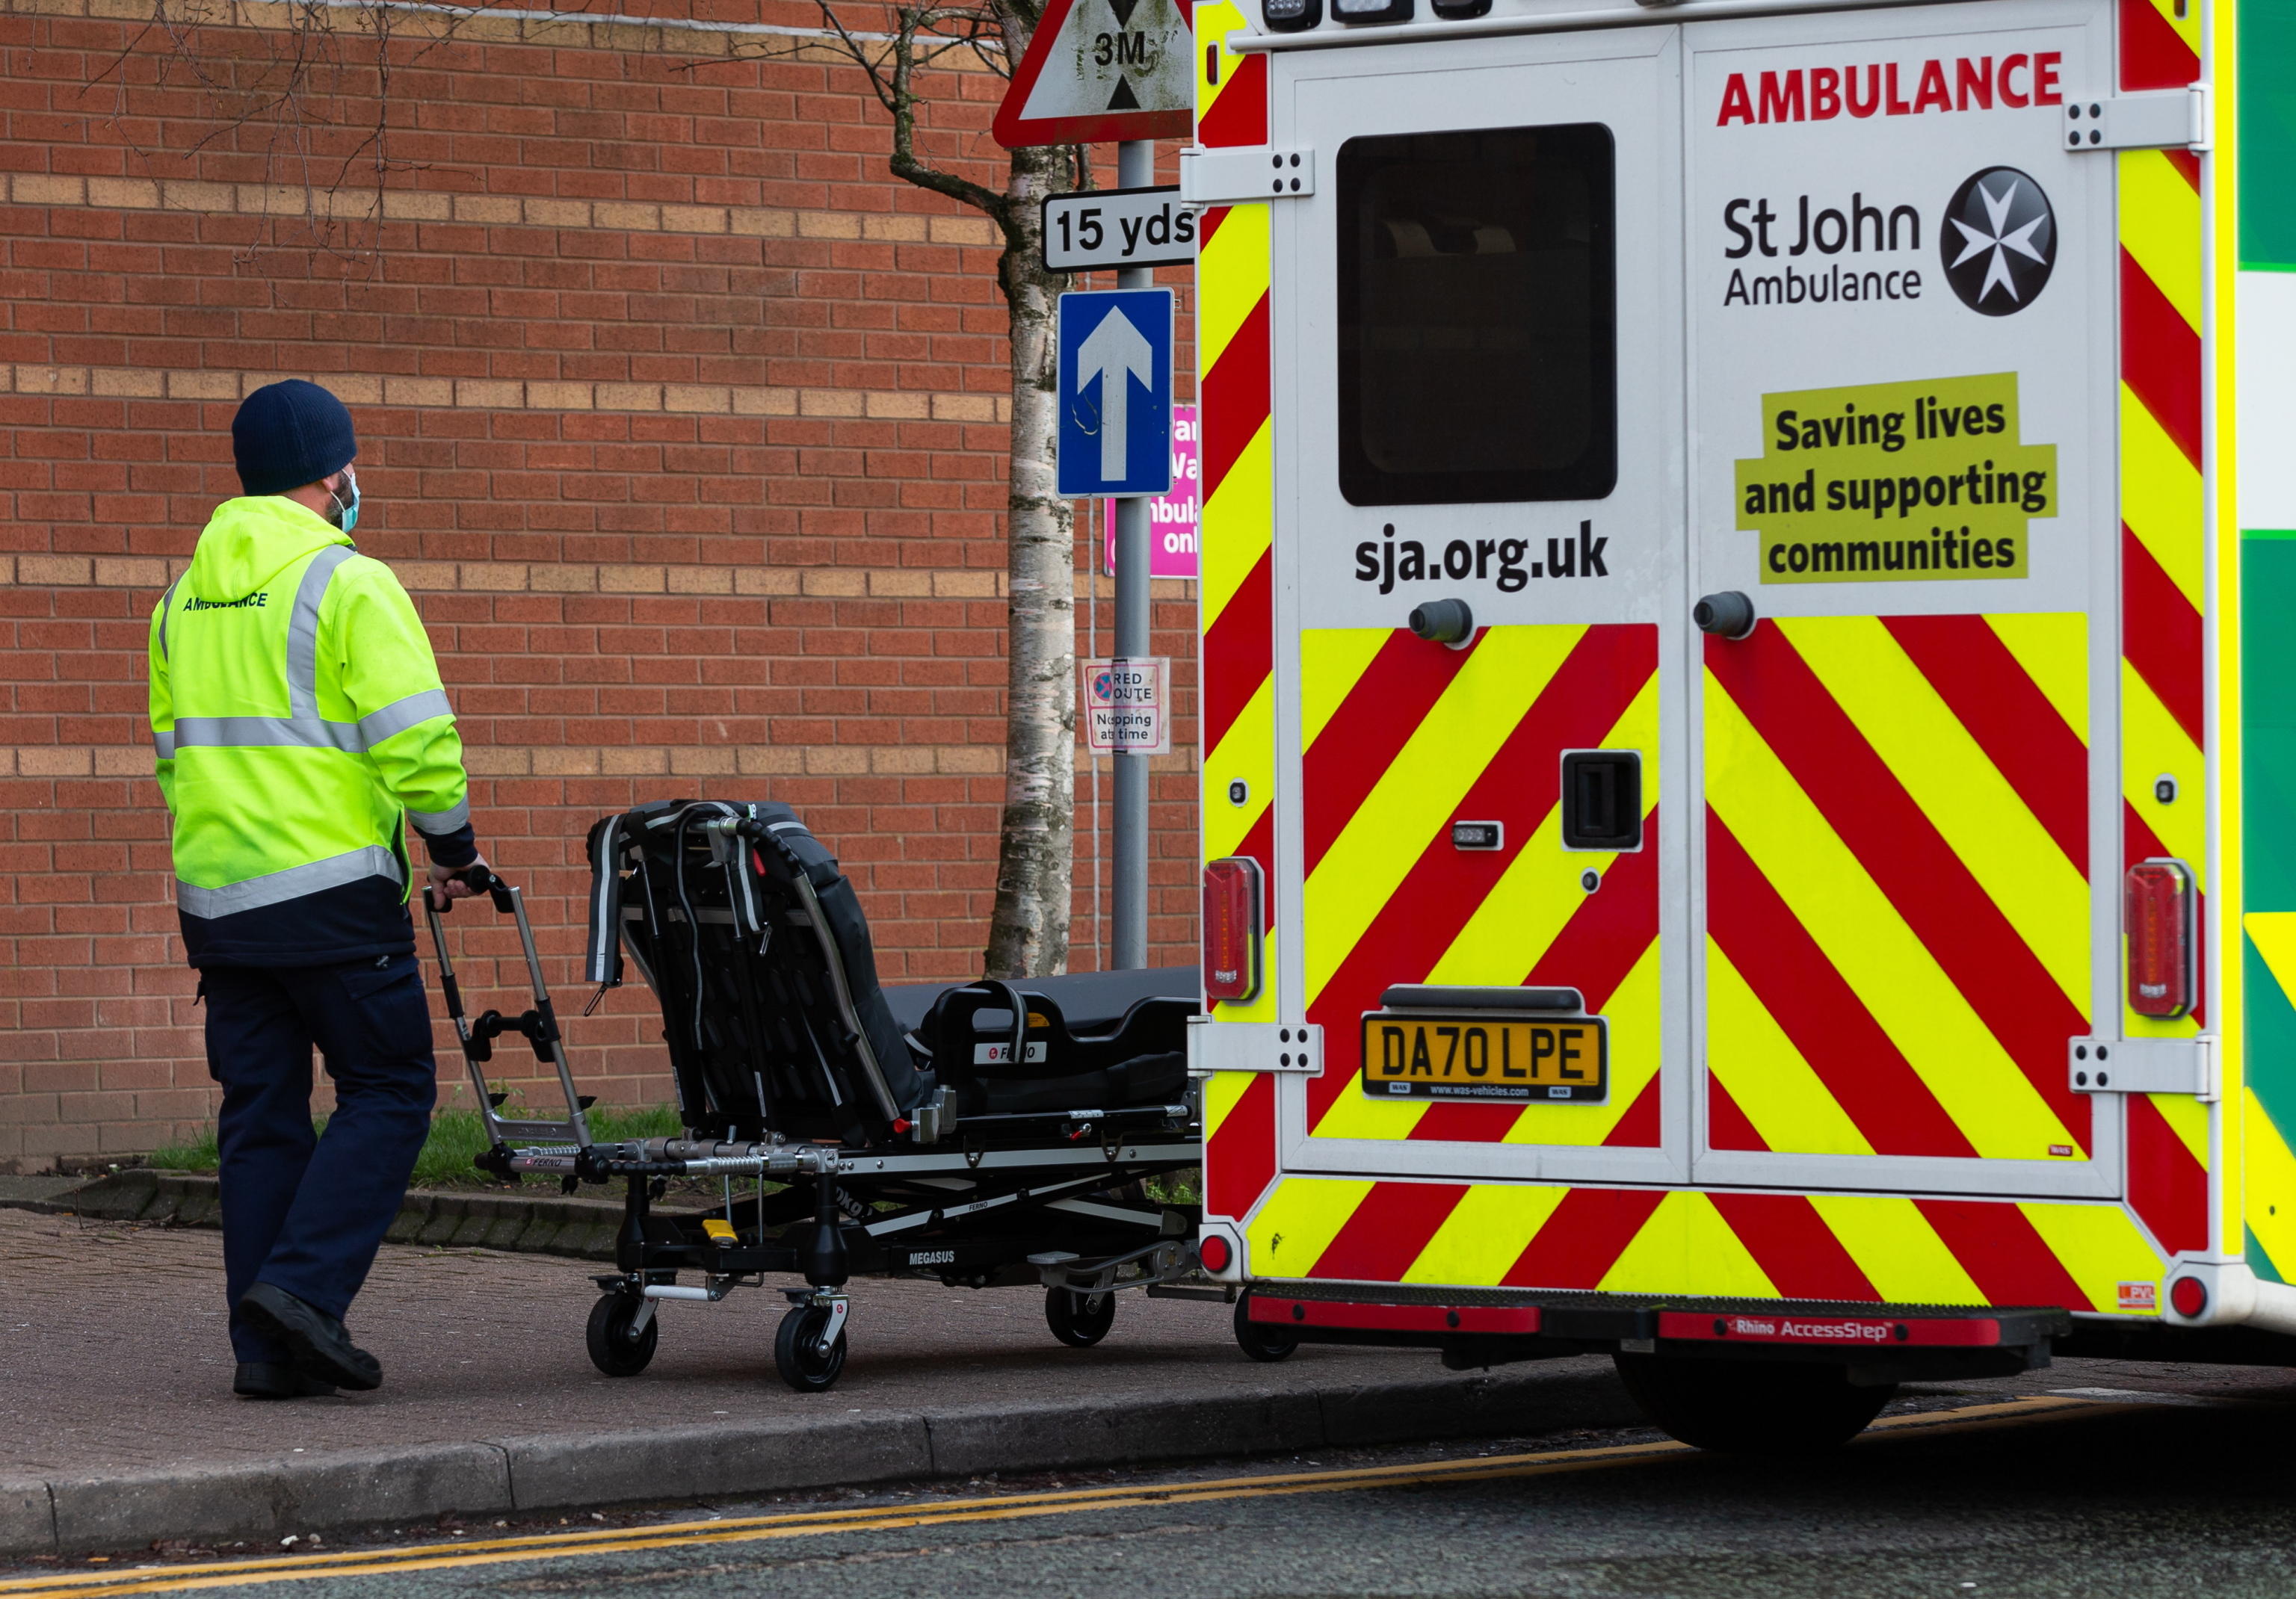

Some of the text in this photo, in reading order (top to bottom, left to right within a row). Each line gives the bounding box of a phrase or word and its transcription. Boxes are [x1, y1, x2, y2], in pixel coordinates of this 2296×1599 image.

[1094, 31, 1145, 66] 3M
[1717, 52, 2062, 126] AMBULANCE
[1057, 203, 1194, 256] 15 yds
[1723, 192, 1921, 259] St John
[1723, 264, 1922, 306] Ambulance
[1776, 396, 2005, 452] Saving lives
[1745, 460, 2047, 519] and supporting
[1164, 526, 1197, 554] onl
[1356, 519, 1608, 595] sja.org.uk
[1768, 526, 2016, 574] communities
[1114, 673, 1141, 684] RED
[1114, 688, 1152, 699] OUTE
[1118, 728, 1148, 739] time
[1382, 1027, 1584, 1079] DA70 LPE
[1431, 1086, 1529, 1096] www.was-vehicles.com
[969, 1201, 988, 1211] FERNO
[910, 1250, 954, 1265] MEGASUS
[1735, 1320, 1775, 1334] Rhino
